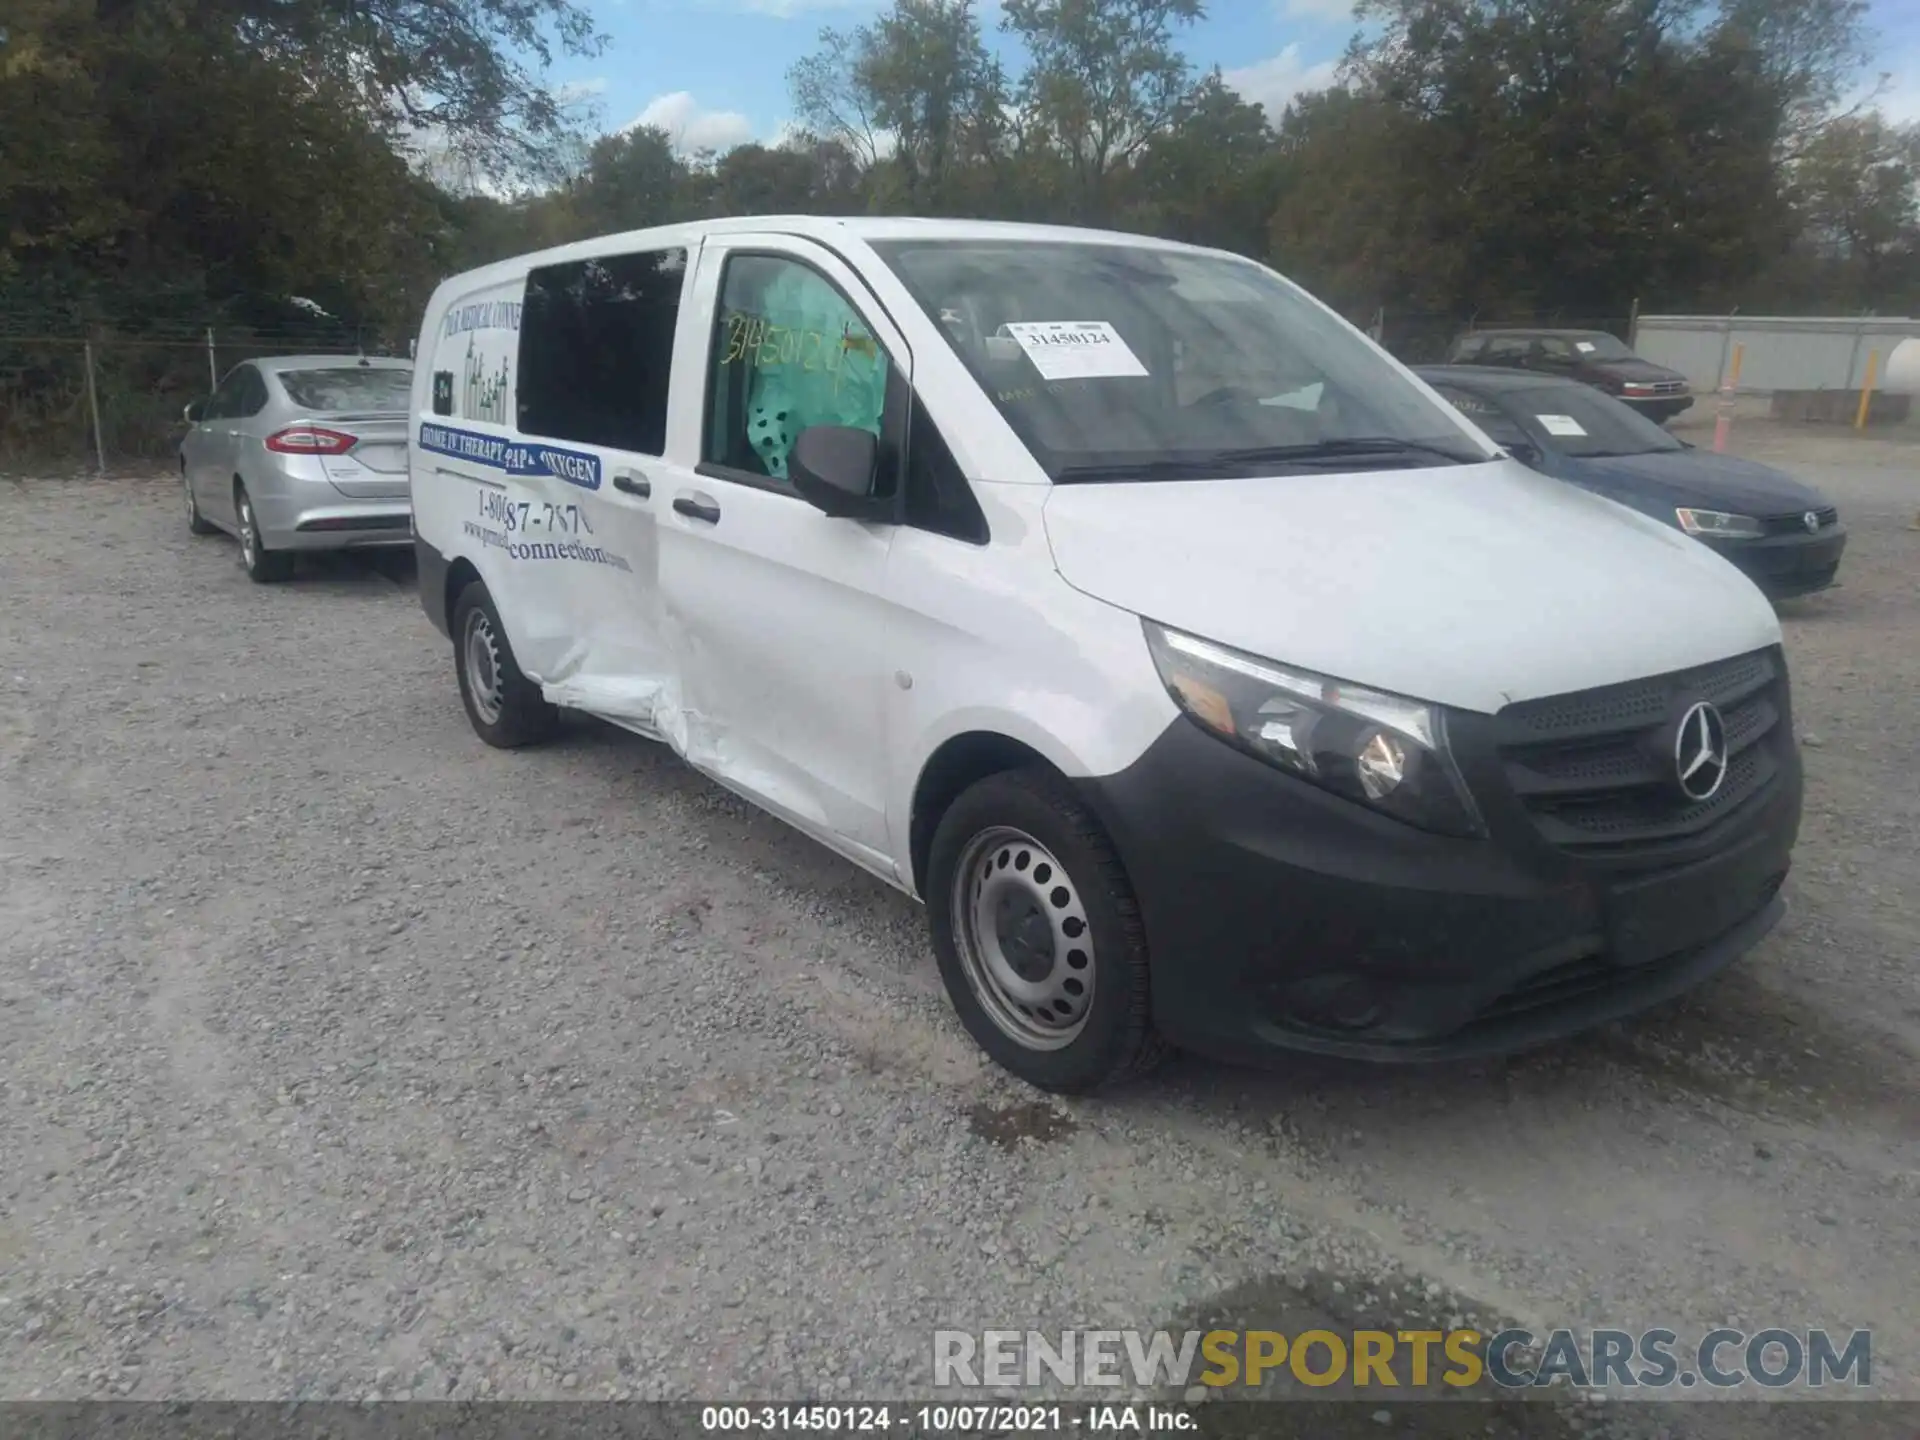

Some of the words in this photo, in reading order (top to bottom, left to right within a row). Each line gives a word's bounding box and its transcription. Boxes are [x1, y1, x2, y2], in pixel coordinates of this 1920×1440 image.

[1028, 333, 1111, 346] 31450124
[421, 425, 446, 450] HOME
[458, 435, 505, 462] THERAPY
[540, 450, 597, 484] OXYGEN
